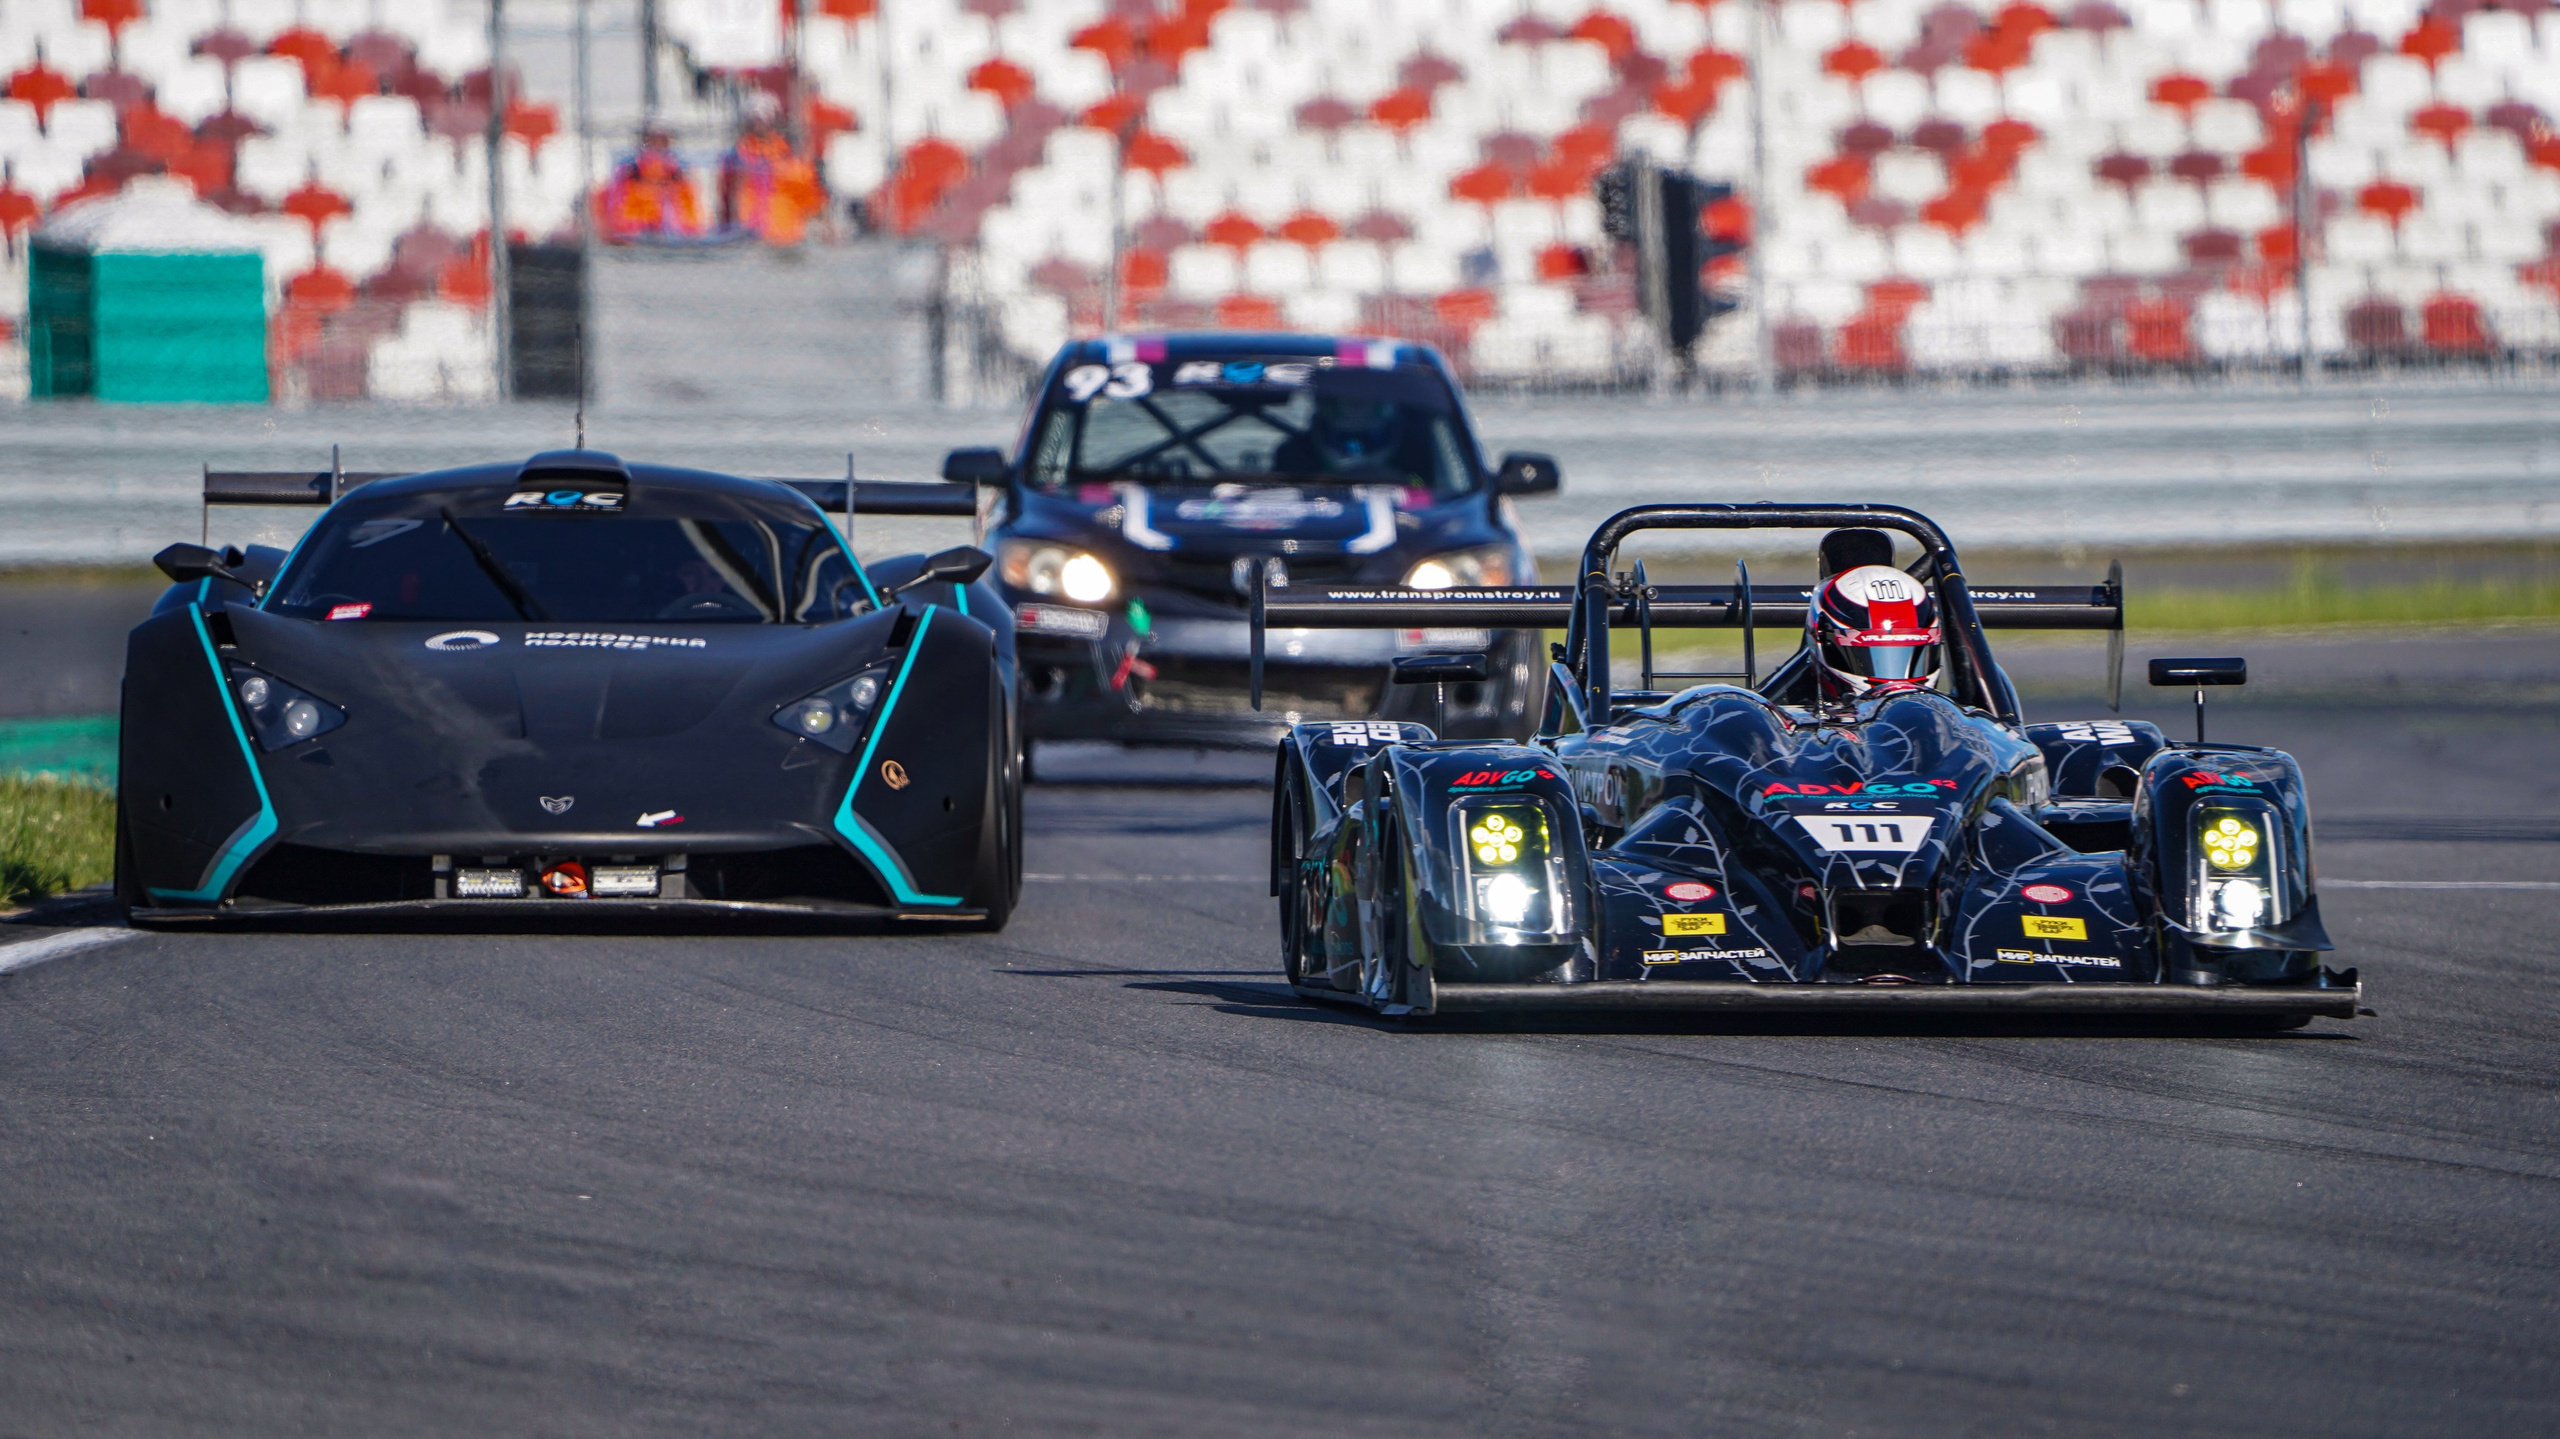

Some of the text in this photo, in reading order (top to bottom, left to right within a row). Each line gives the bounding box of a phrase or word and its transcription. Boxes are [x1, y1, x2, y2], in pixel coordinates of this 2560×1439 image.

[1063, 360, 1153, 402] 93
[1327, 589, 1561, 600] www.transpromstroy.ru
[1870, 579, 1905, 601] 111
[525, 632, 707, 649] МОСКОВСКИЙ
[1831, 823, 1904, 843] 111
[1644, 947, 1766, 963] МИР ЗАПЧАСТЕЙ
[1997, 951, 2121, 967] МИР ЗАПЧАСТЕЙ
